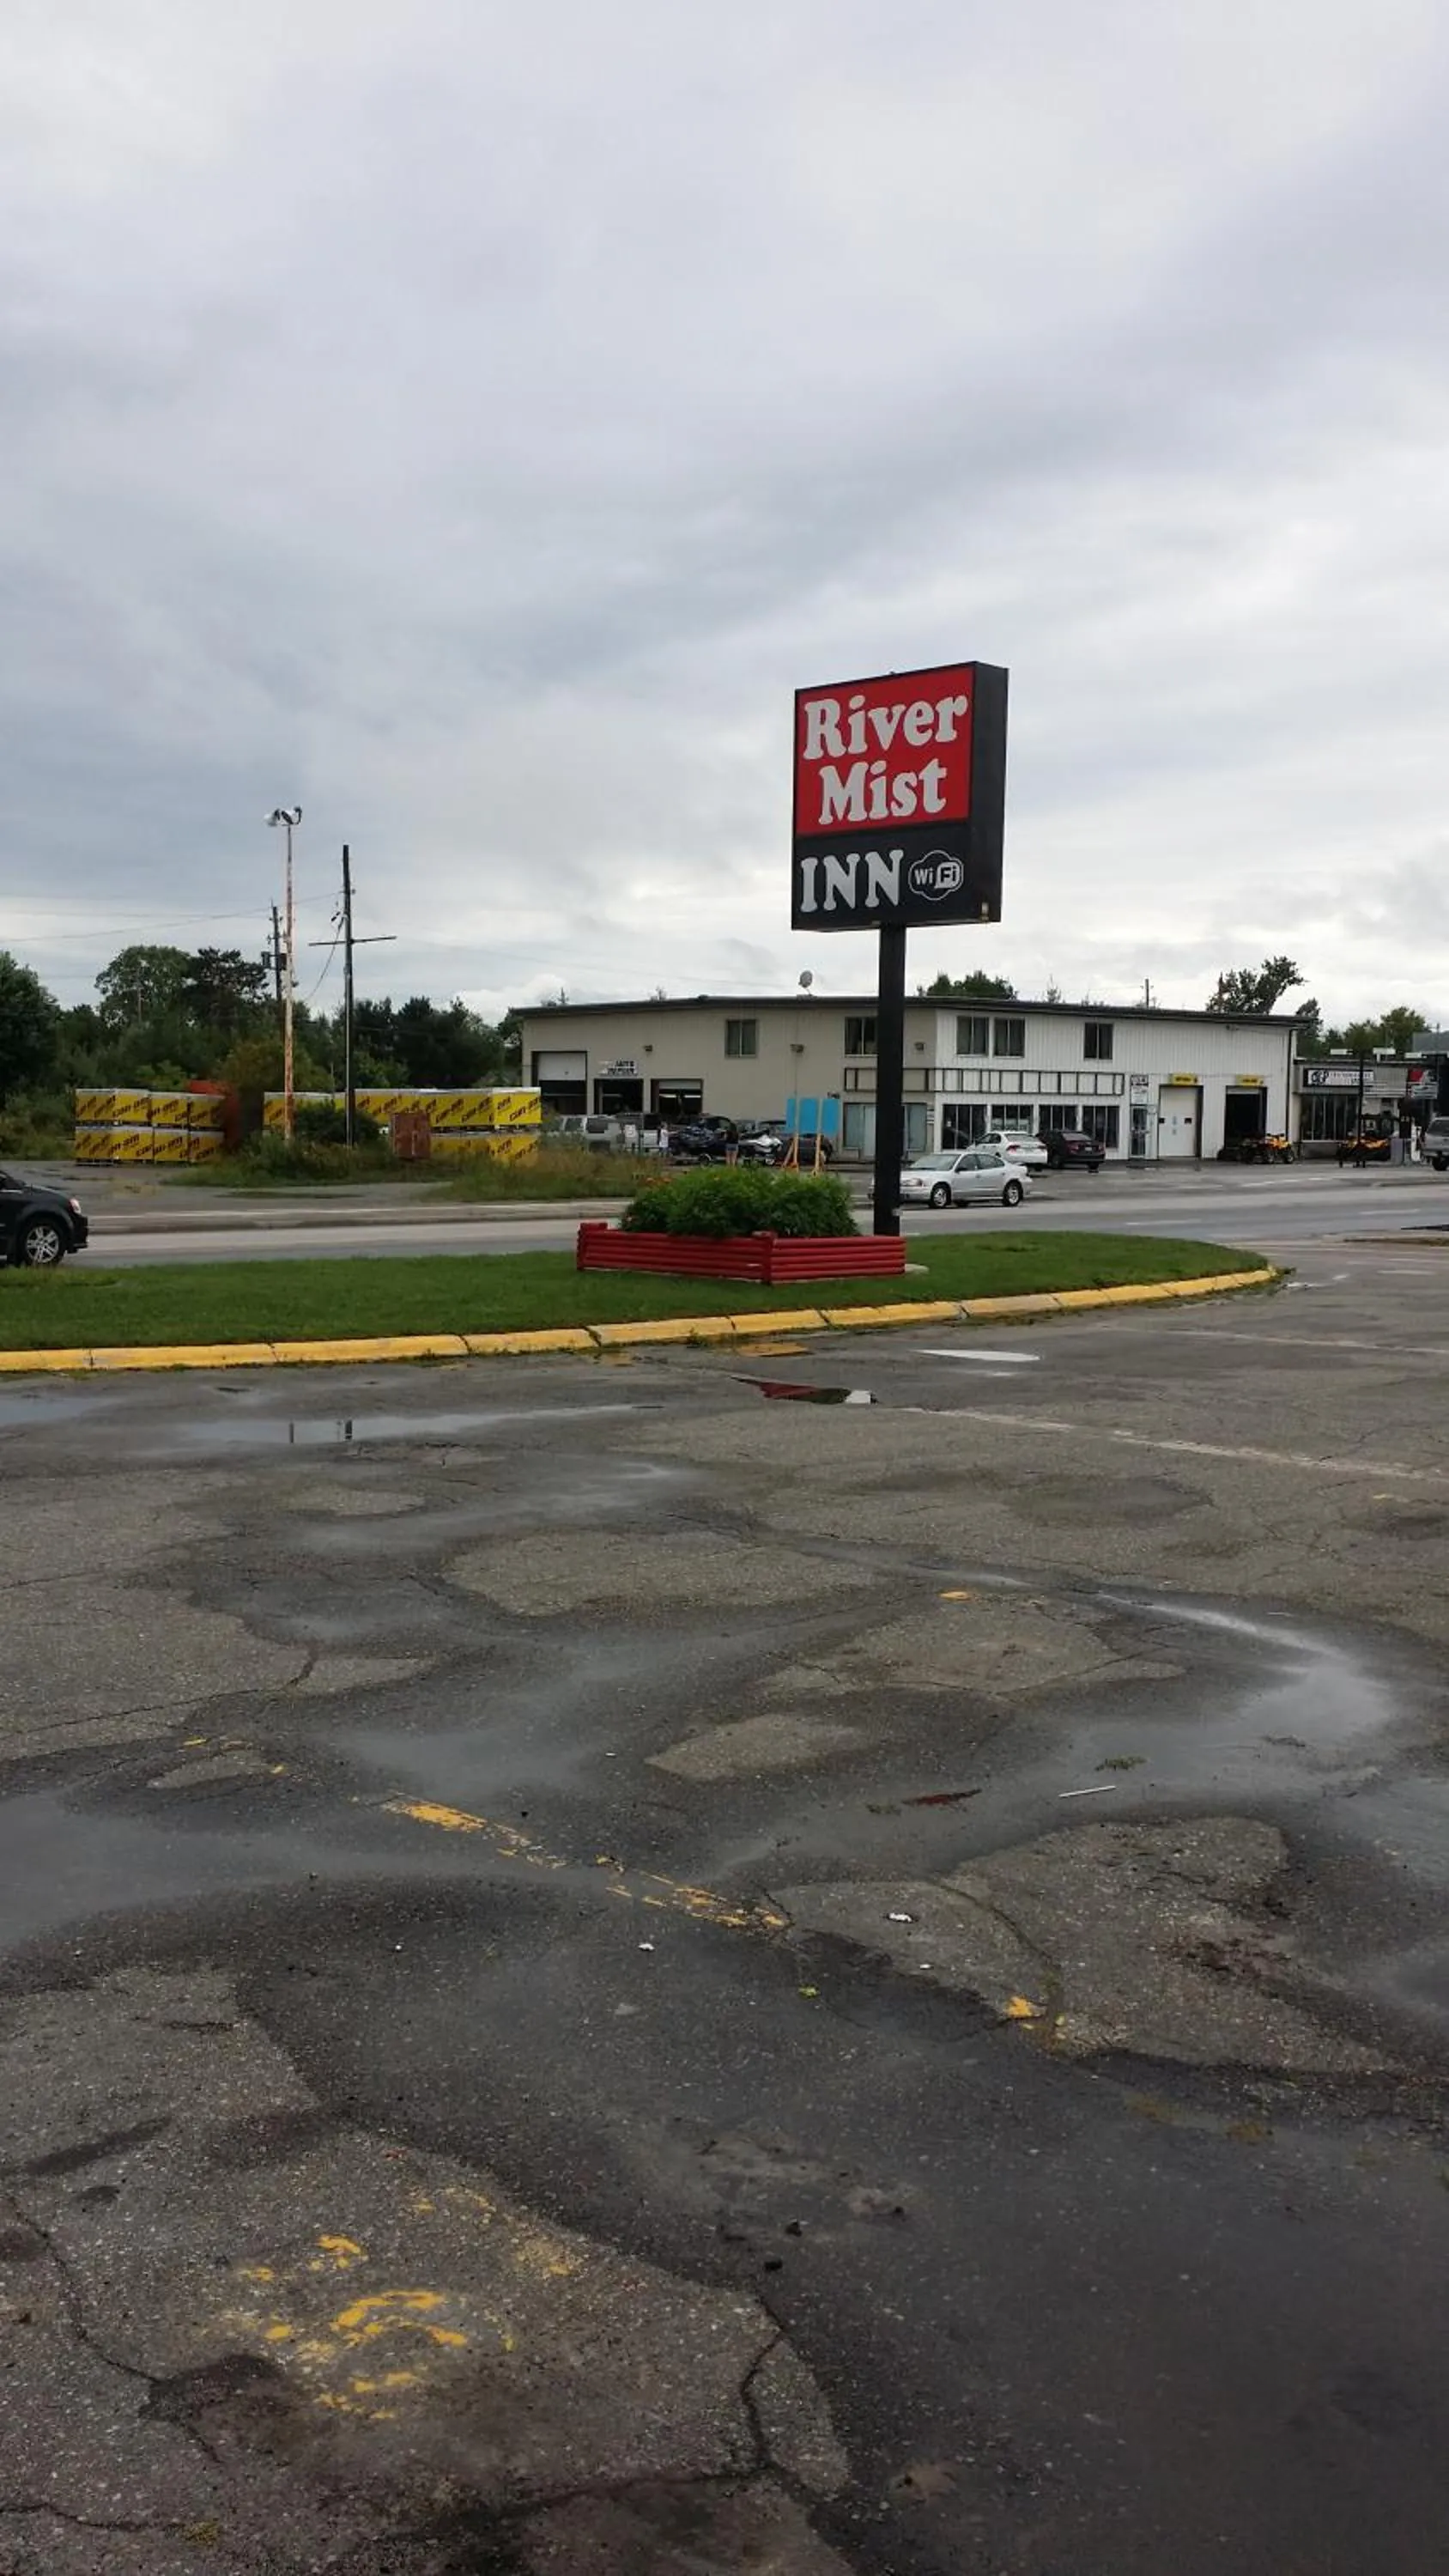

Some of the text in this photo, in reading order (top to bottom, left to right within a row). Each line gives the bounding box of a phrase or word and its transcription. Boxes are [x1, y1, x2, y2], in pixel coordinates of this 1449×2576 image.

[803, 695, 968, 760] River
[818, 758, 947, 825] Mist
[800, 849, 904, 912] INN
